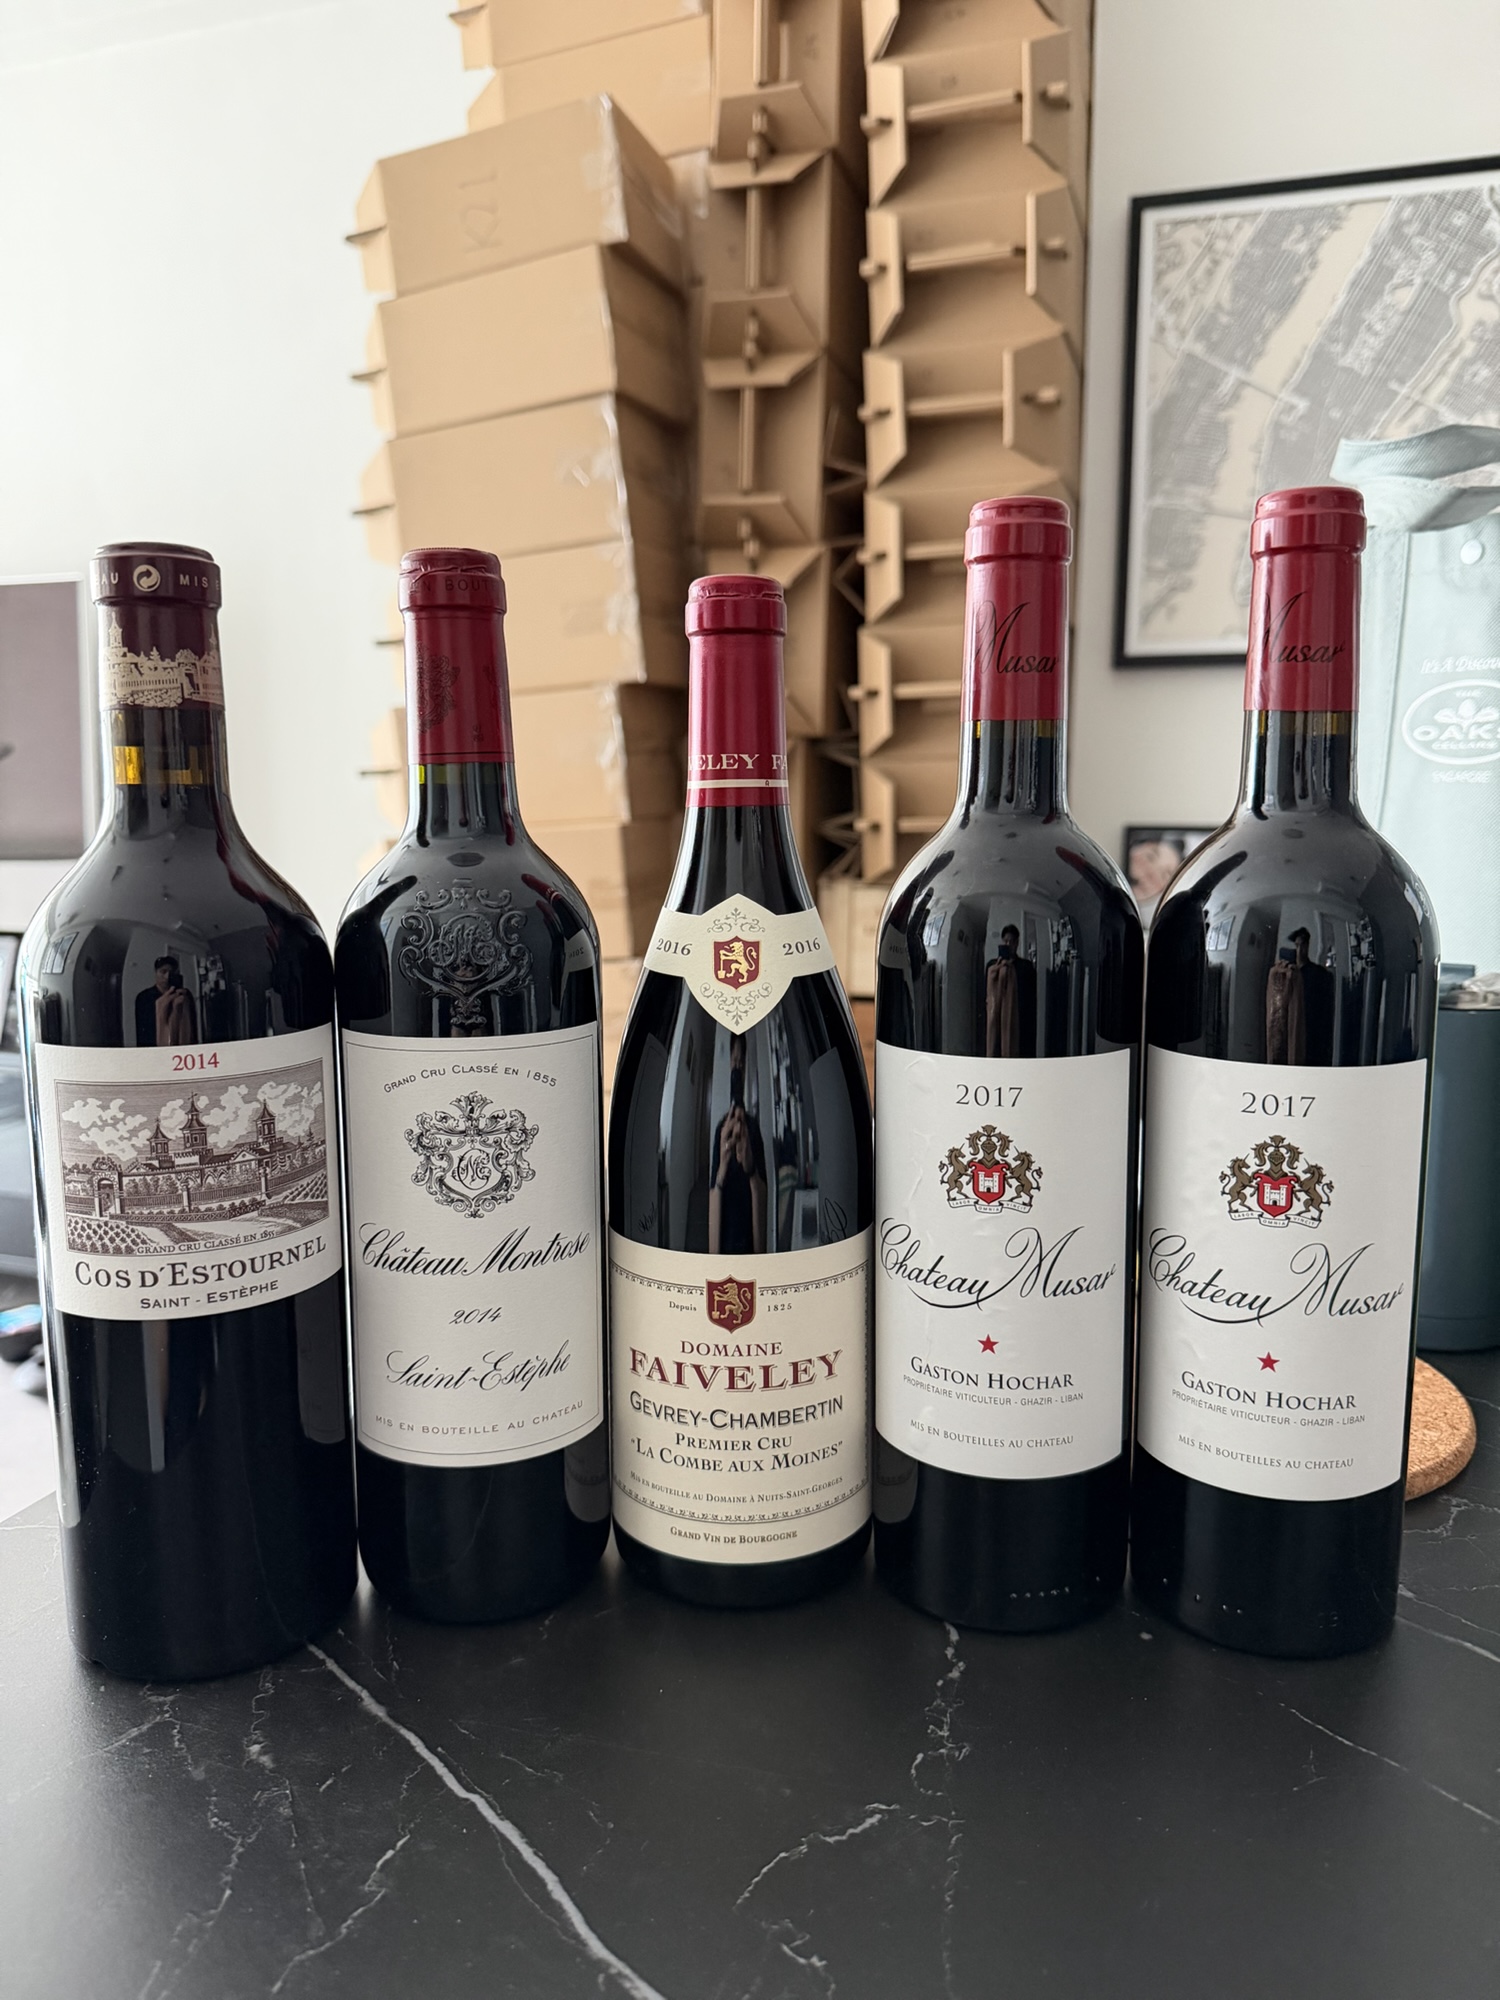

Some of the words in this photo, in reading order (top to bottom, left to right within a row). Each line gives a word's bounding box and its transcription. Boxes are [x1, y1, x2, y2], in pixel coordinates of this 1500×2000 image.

[179, 574, 209, 588] MIS
[974, 600, 1059, 675] Musar
[656, 937, 693, 957] 2016
[782, 936, 821, 956] 2016
[171, 1052, 220, 1072] 2014
[383, 1075, 417, 1094] GRAND
[420, 1067, 447, 1079] CRU
[451, 1063, 499, 1075] CLASSÉ
[503, 1067, 519, 1076] EN
[525, 1069, 558, 1087] 1855
[955, 1083, 1023, 1108] 2017
[1240, 1091, 1316, 1118] 2017
[137, 1243, 176, 1255] GRAND
[178, 1241, 201, 1252] CRU
[204, 1233, 242, 1250] CLASSÉ
[243, 1233, 258, 1243] EN
[260, 1230, 276, 1240] 1855
[359, 1222, 467, 1276] Château
[462, 1225, 591, 1276] Montrose
[75, 1260, 132, 1289] COS
[139, 1235, 327, 1288] D'ESTOURNEL
[880, 1217, 990, 1311] Chateau
[1004, 1225, 1117, 1299] Musar
[1149, 1227, 1273, 1328] Chateau
[1290, 1242, 1404, 1317] Musar
[140, 1295, 191, 1310] SAINT
[207, 1279, 279, 1304] ESTÈPHE
[668, 1300, 697, 1312] Depuis
[766, 1302, 793, 1312] 1825
[449, 1306, 503, 1325] 2014
[680, 1340, 783, 1357] DOMAINE
[629, 1346, 843, 1393] FAIVELEY
[910, 1356, 979, 1388] GASTON
[987, 1372, 1074, 1391] HOCHAR
[903, 1374, 953, 1398] PROPRIÉTAIRE
[955, 1391, 1012, 1406] VITICULTEUR
[1020, 1396, 1053, 1406] GHAZIR
[1060, 1392, 1084, 1404] LIBAN
[1181, 1370, 1257, 1405] GASTON
[1265, 1390, 1357, 1411] HOCHAR
[375, 1414, 393, 1428] MIS
[399, 1421, 415, 1432] EN
[421, 1423, 500, 1436] BOUTEILLE
[507, 1419, 525, 1431] AU
[532, 1399, 585, 1426] CHATEAU
[629, 1390, 844, 1430] GEVREY-CHAMBERTIN
[1171, 1388, 1228, 1415] PROPRIÉTAIRE
[1230, 1408, 1291, 1426] VITICULTEUR
[1300, 1417, 1334, 1427] GHAZIR
[1342, 1414, 1366, 1426] LIBAN
[675, 1431, 751, 1451] PREMIER
[757, 1435, 793, 1450] CRU
[910, 1419, 925, 1432] MIS
[927, 1425, 940, 1437] EN
[943, 1430, 1005, 1448] BOUTEILLES
[1008, 1439, 1023, 1449] AU
[1026, 1435, 1074, 1449] CHATEAU
[659, 1447, 723, 1472] COMBE
[727, 1459, 764, 1473] AUX
[1178, 1434, 1195, 1447] MIS
[1198, 1441, 1212, 1454] EN
[1215, 1447, 1282, 1468] BOUTEILLES
[1285, 1459, 1301, 1469] AU
[1304, 1458, 1354, 1470] CHATEAU
[651, 1481, 691, 1499] BOUTEILLE
[692, 1493, 704, 1501] AU
[706, 1493, 747, 1503] DOMAINE
[670, 1525, 701, 1540] GRAND
[703, 1533, 721, 1543] VIN
[723, 1535, 736, 1544] DE
[739, 1530, 798, 1544] BOURGOGNE
